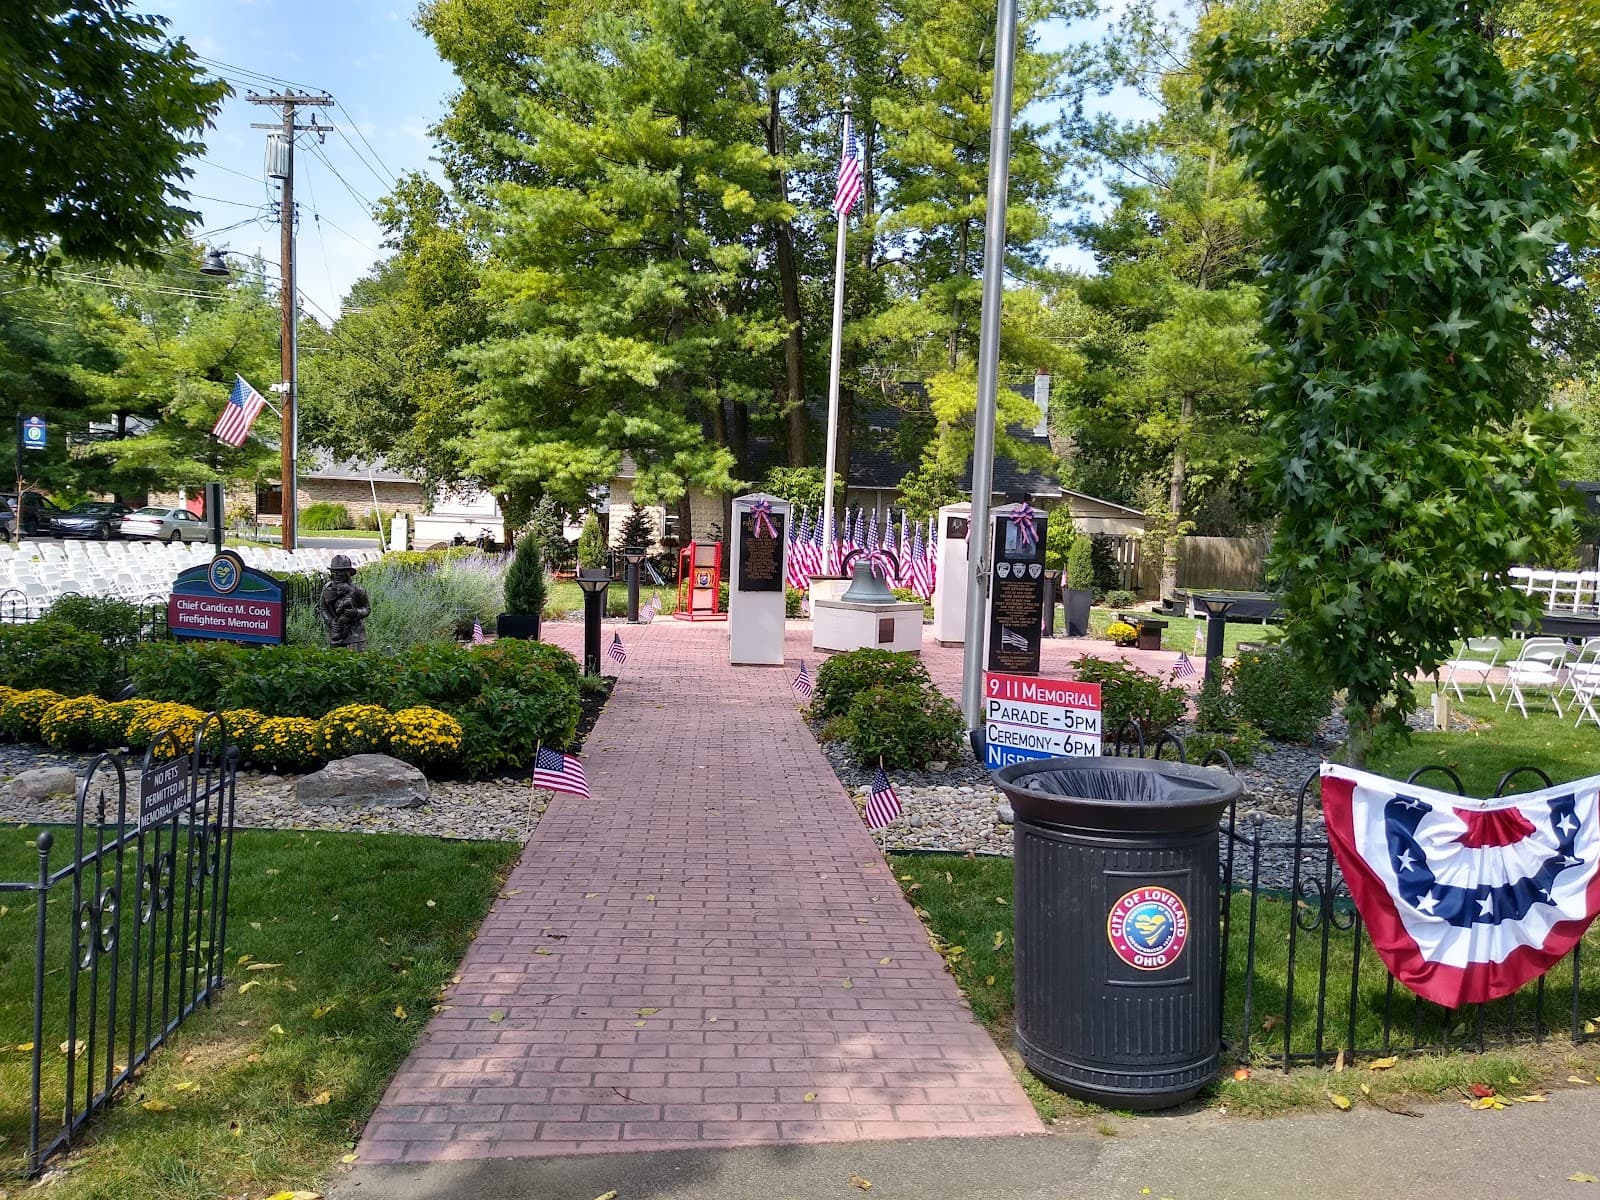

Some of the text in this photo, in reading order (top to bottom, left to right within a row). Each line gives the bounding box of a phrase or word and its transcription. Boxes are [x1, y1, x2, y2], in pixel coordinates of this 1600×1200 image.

[177, 600, 271, 616] Chief Candice M. Cook
[179, 613, 269, 630] Firefighters Memorial
[1022, 682, 1097, 707] MEMORIAL
[990, 700, 1048, 725] PARADE
[1064, 709, 1097, 732] 5PM
[988, 724, 1052, 750] CEREMONY
[1063, 734, 1096, 758] 6PM
[154, 766, 178, 787] NO PETS
[145, 779, 184, 808] PERMITTED IN
[141, 794, 186, 828] MEMORIAL AREA
[1112, 890, 1186, 938] CITY OF LOVELAND
[1134, 954, 1166, 966] OHIO
